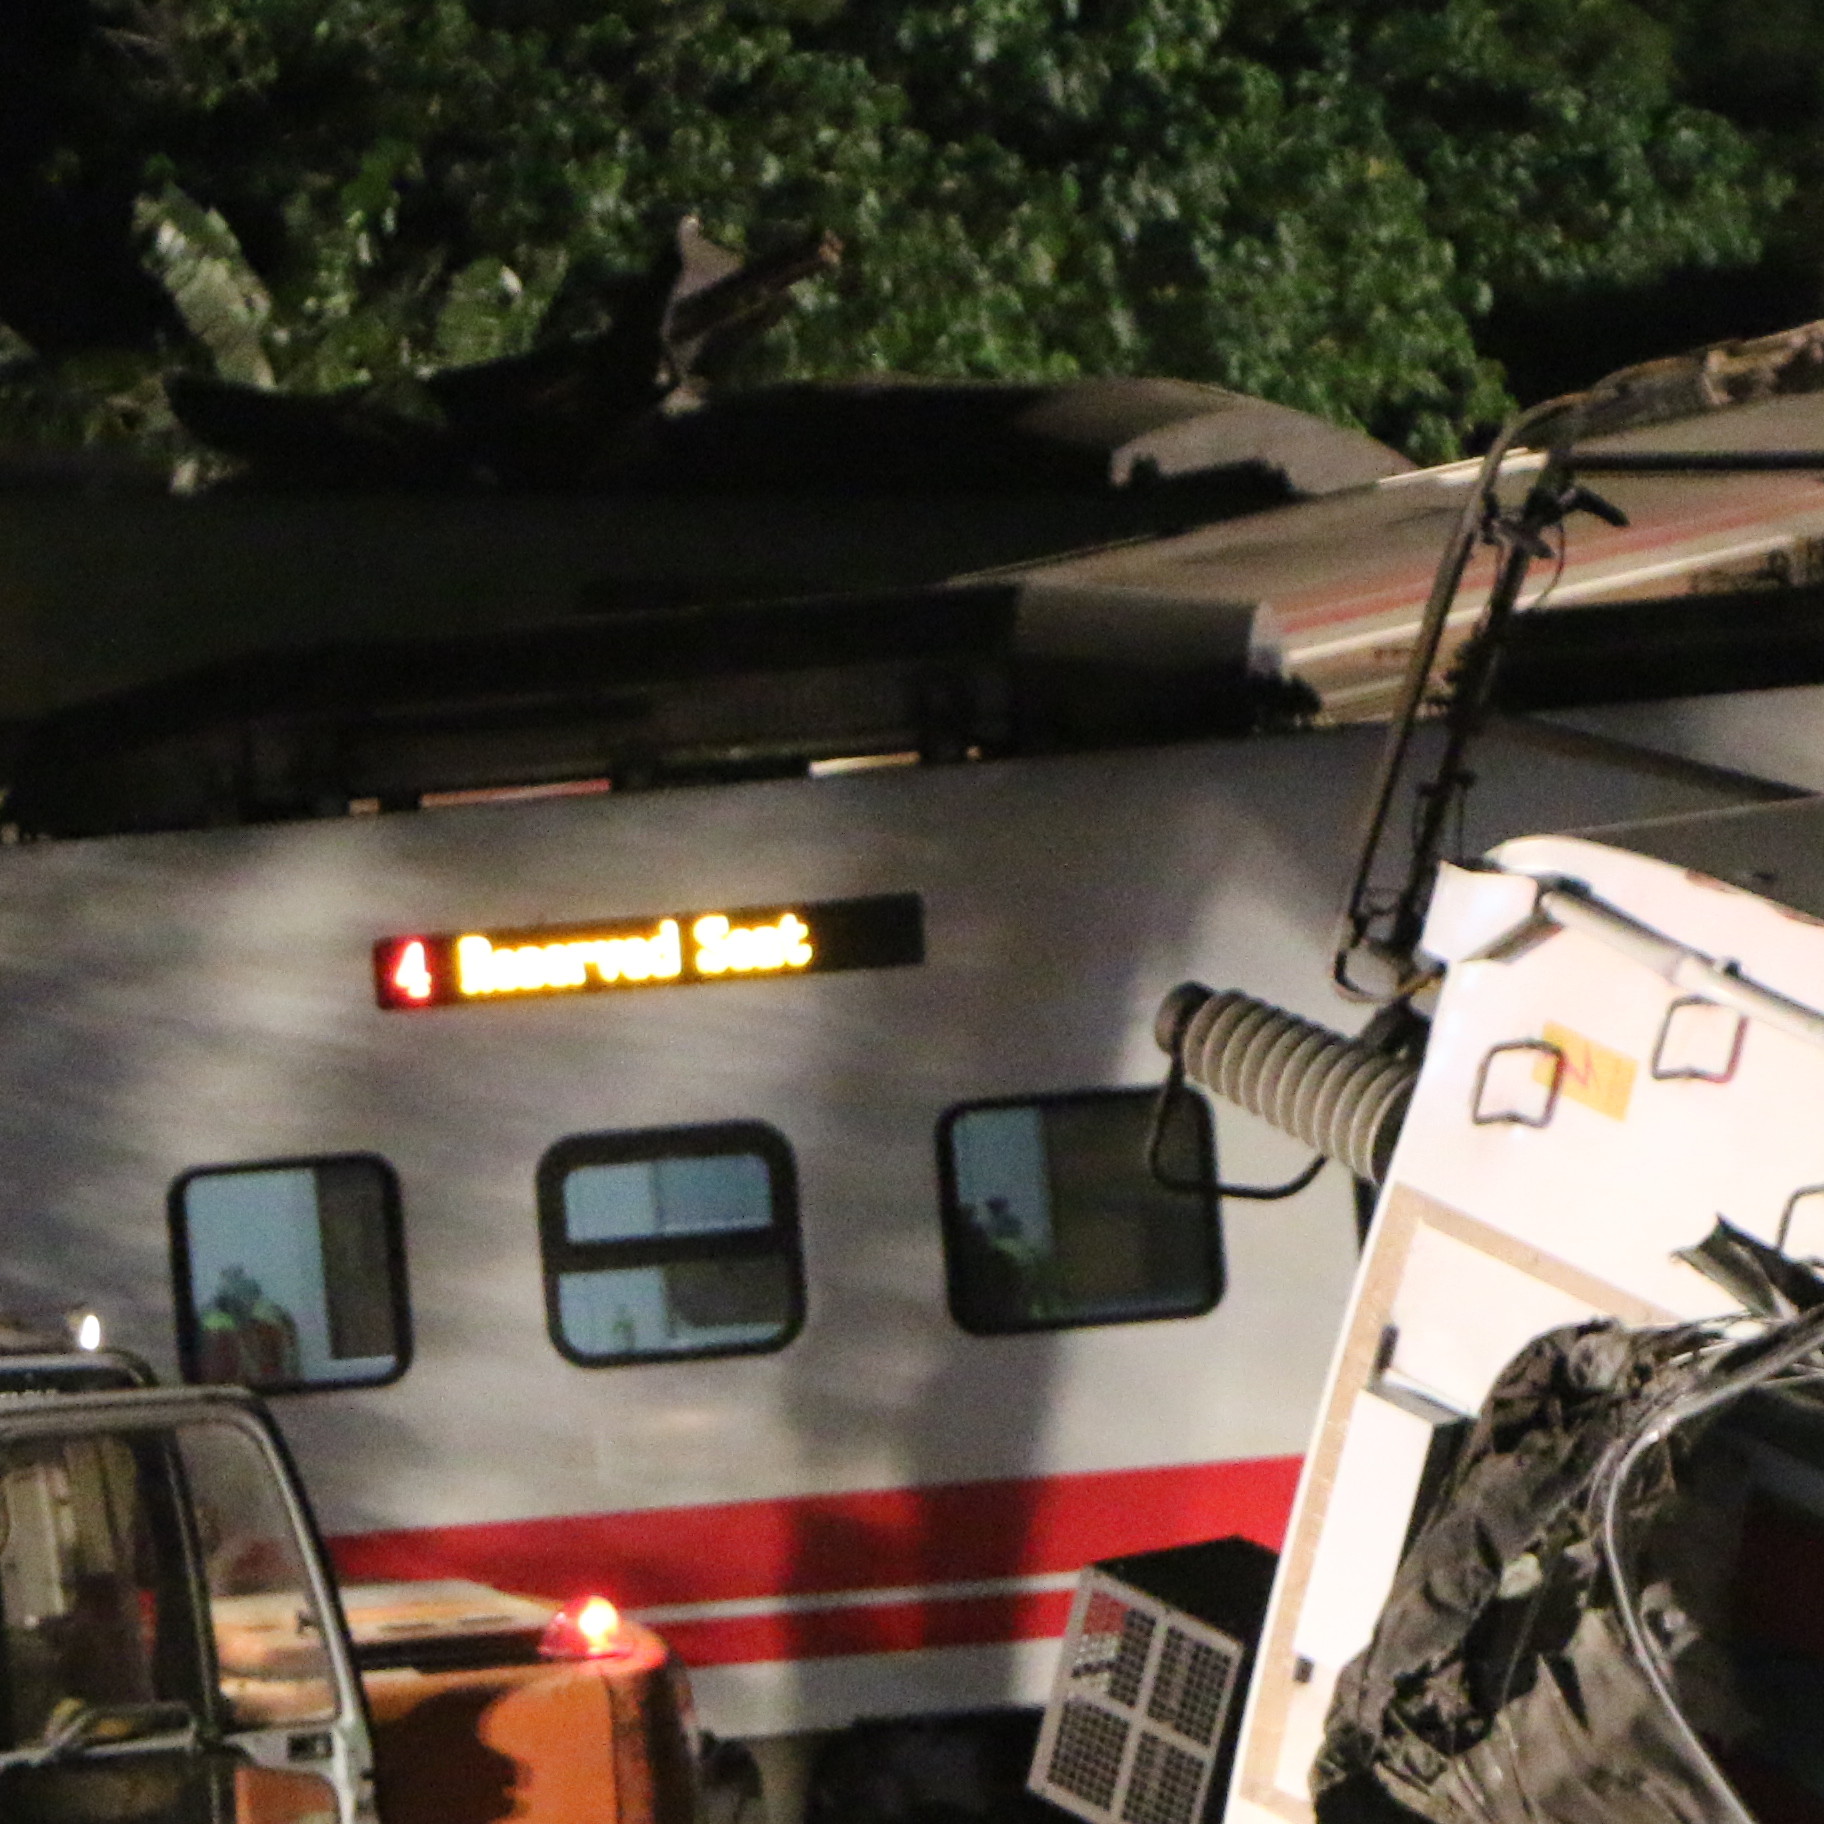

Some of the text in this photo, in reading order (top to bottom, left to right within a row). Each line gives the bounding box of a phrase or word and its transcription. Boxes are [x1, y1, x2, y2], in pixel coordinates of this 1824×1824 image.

[393, 914, 812, 1001] 4 Reserved Seat
